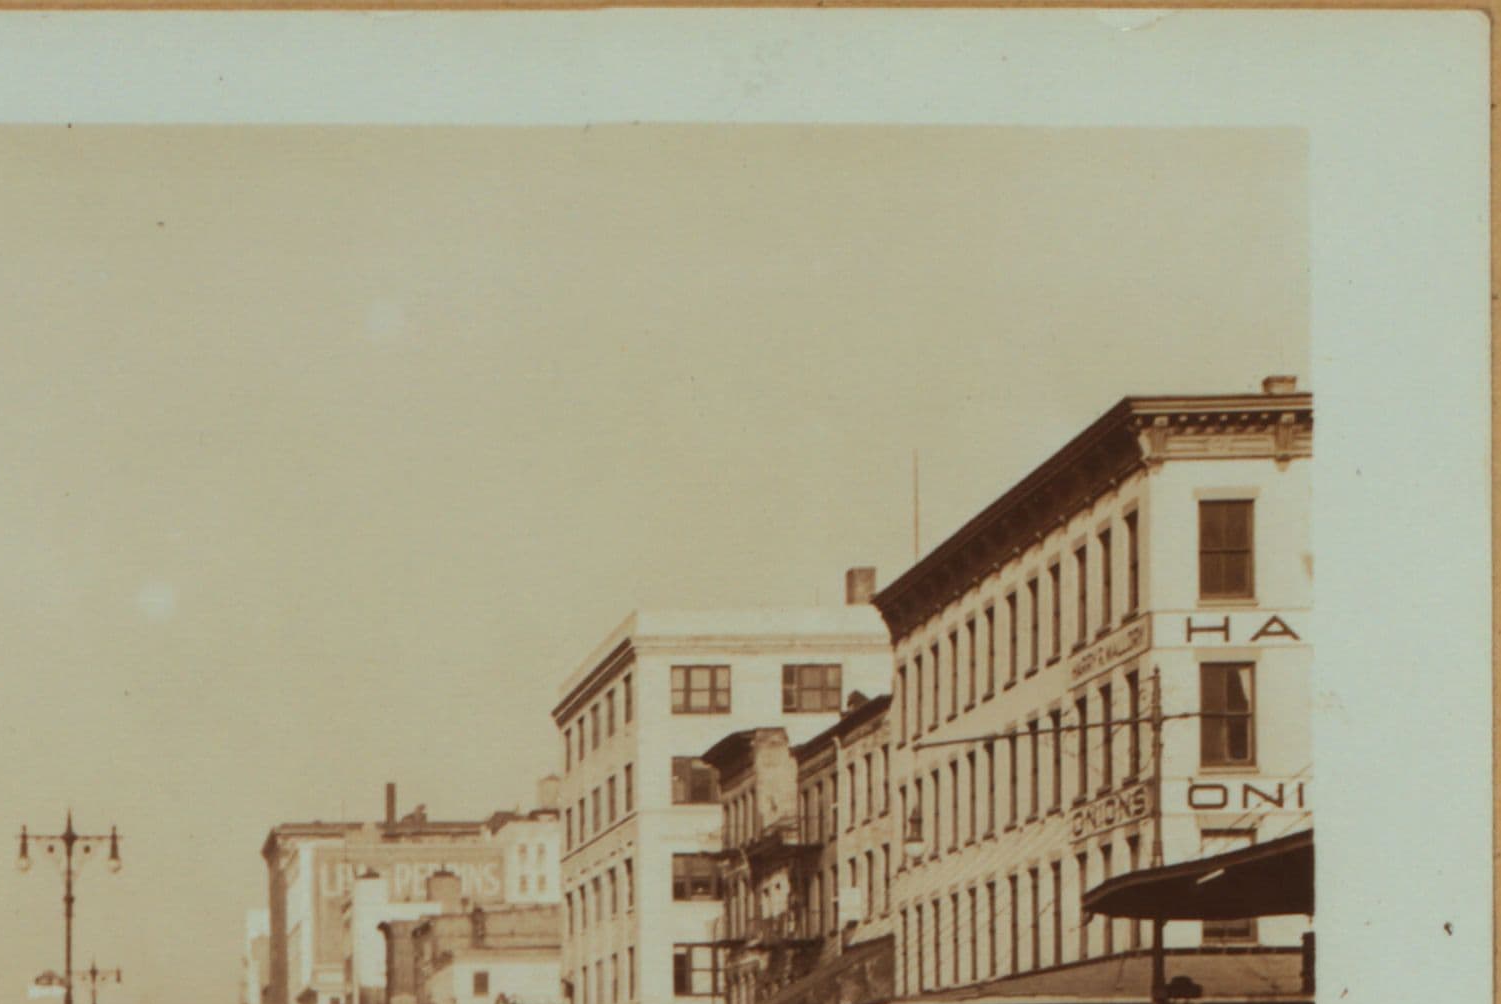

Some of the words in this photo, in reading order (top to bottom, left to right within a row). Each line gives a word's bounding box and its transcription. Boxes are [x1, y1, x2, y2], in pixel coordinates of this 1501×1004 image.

[1186, 615, 1301, 643] HA
[1073, 787, 1145, 836] ONIONS
[1187, 781, 1305, 810] ONI
[393, 862, 499, 897] PEINS
